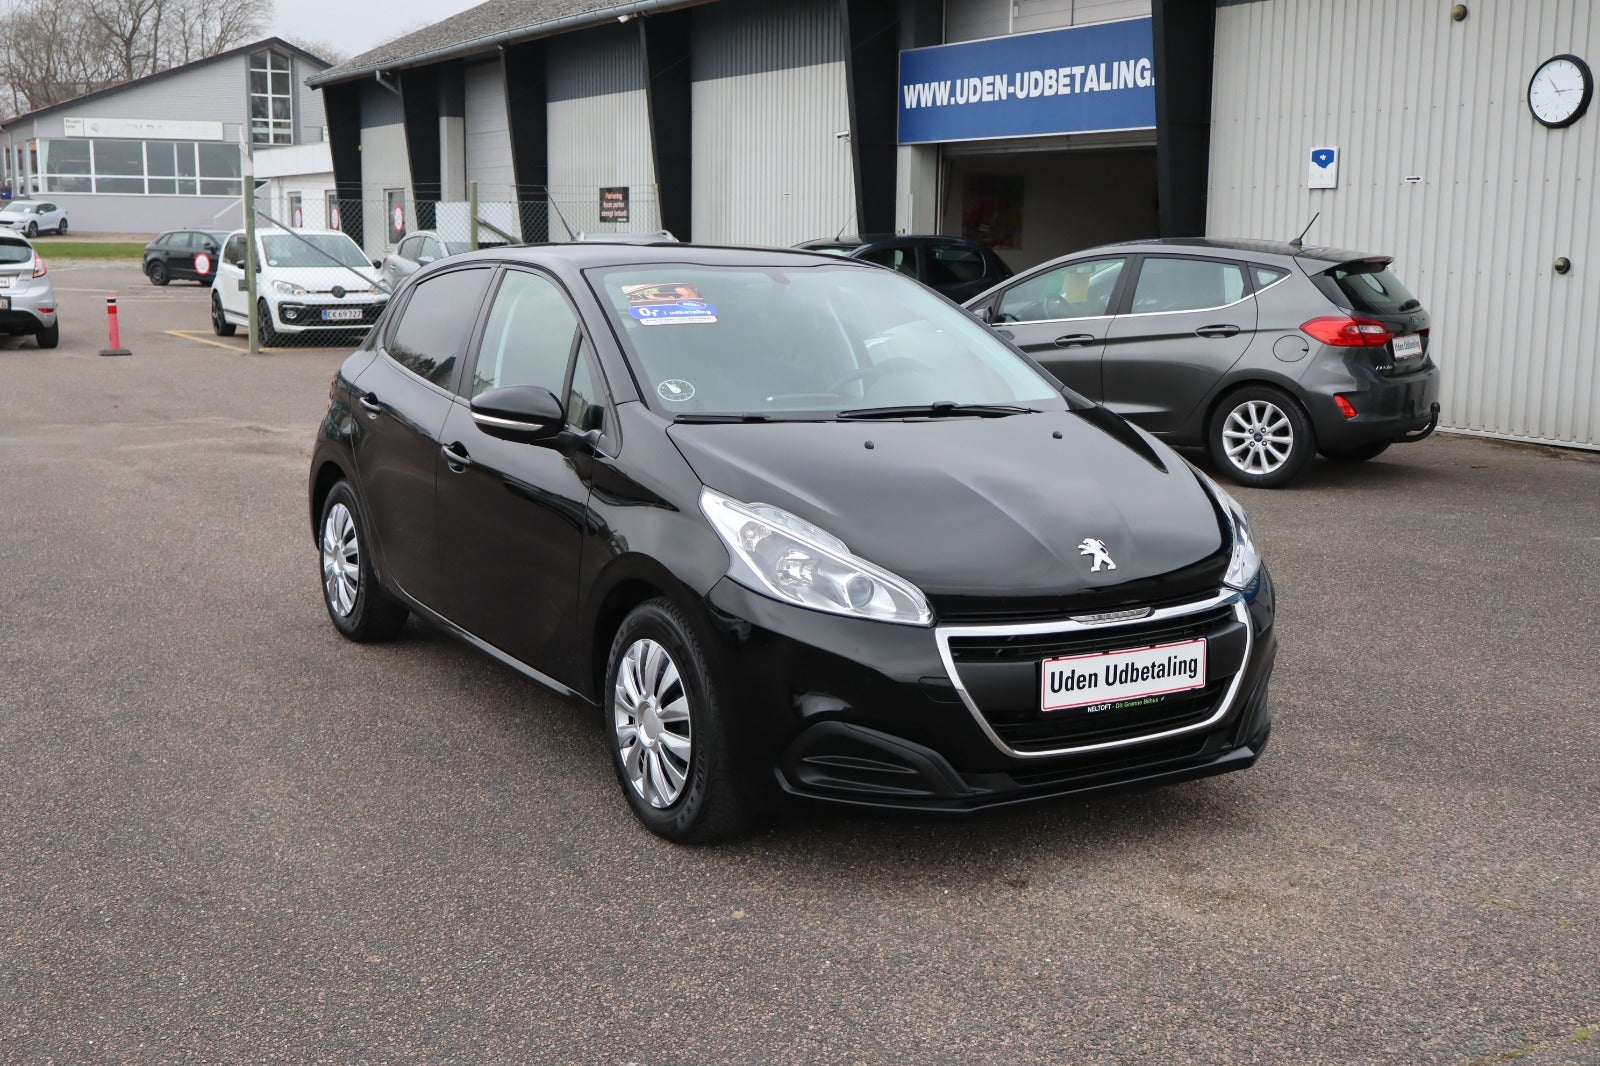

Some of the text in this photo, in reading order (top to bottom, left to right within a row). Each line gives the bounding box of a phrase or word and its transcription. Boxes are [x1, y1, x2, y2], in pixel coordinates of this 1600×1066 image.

[1050, 655, 1198, 694] Uden Udbetaling
[1087, 703, 1112, 713] NELTOFT
